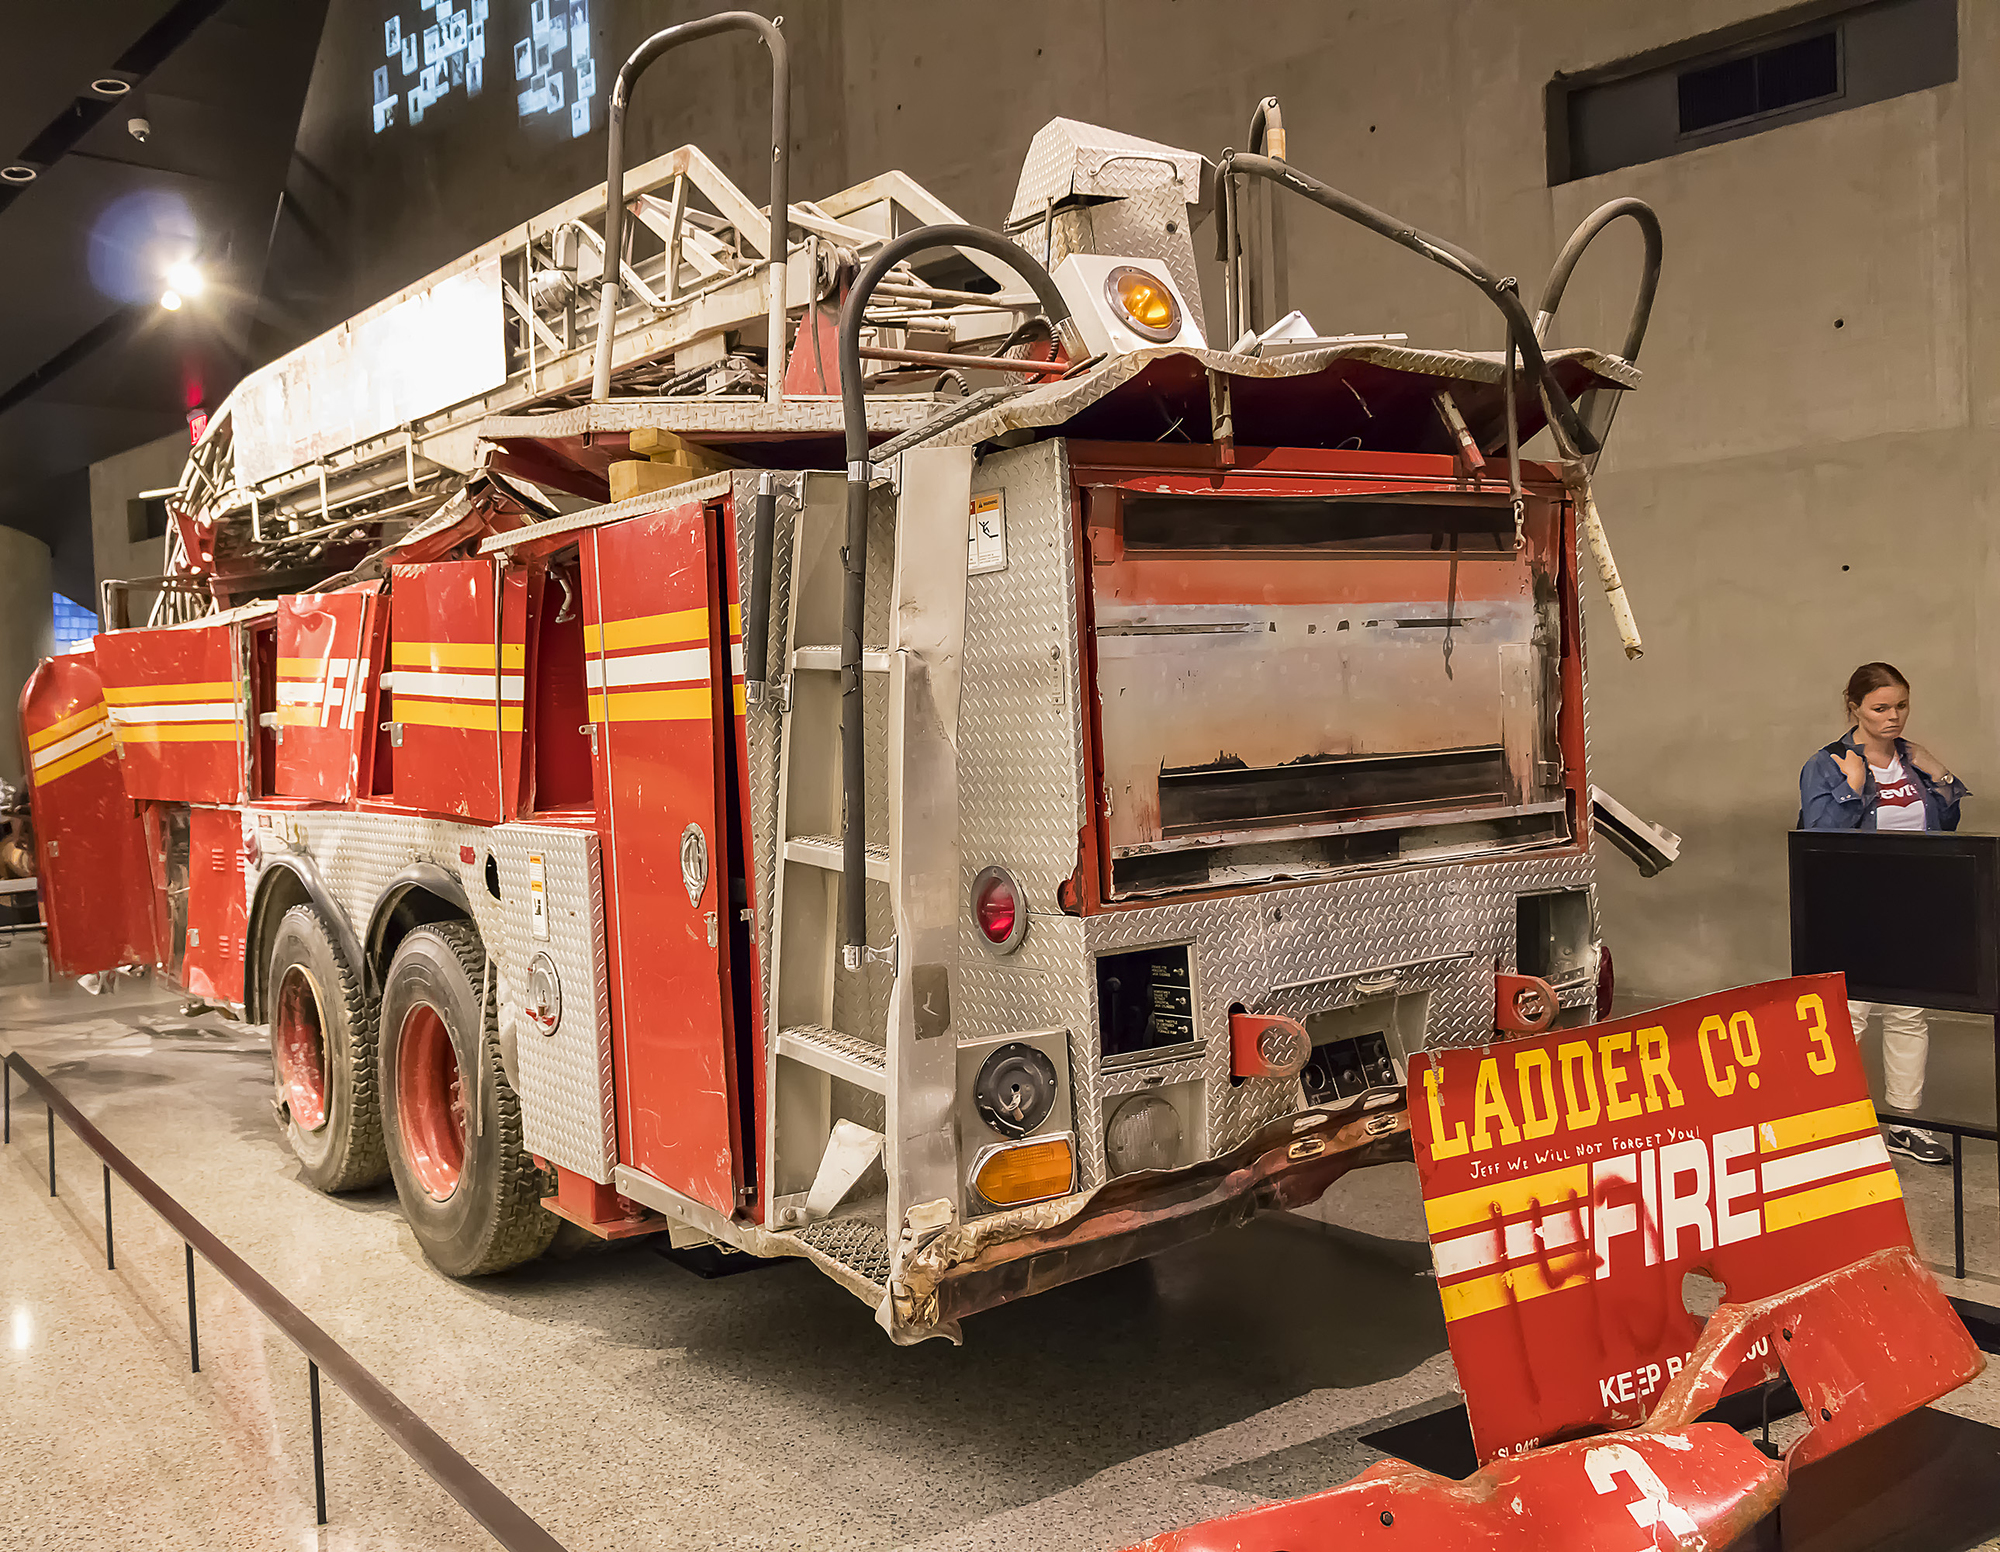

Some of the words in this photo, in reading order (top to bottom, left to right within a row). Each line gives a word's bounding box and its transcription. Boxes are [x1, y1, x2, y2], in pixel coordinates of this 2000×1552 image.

[1423, 1025, 1685, 1161] LADDER
[1795, 993, 1836, 1076] 3
[1470, 1160, 1500, 1179] JEFF
[1575, 1143, 1602, 1157] NOT
[1612, 1133, 1661, 1150] FORGET
[1592, 1125, 1761, 1280] FIRE
[1599, 1363, 1661, 1408] KEEP
